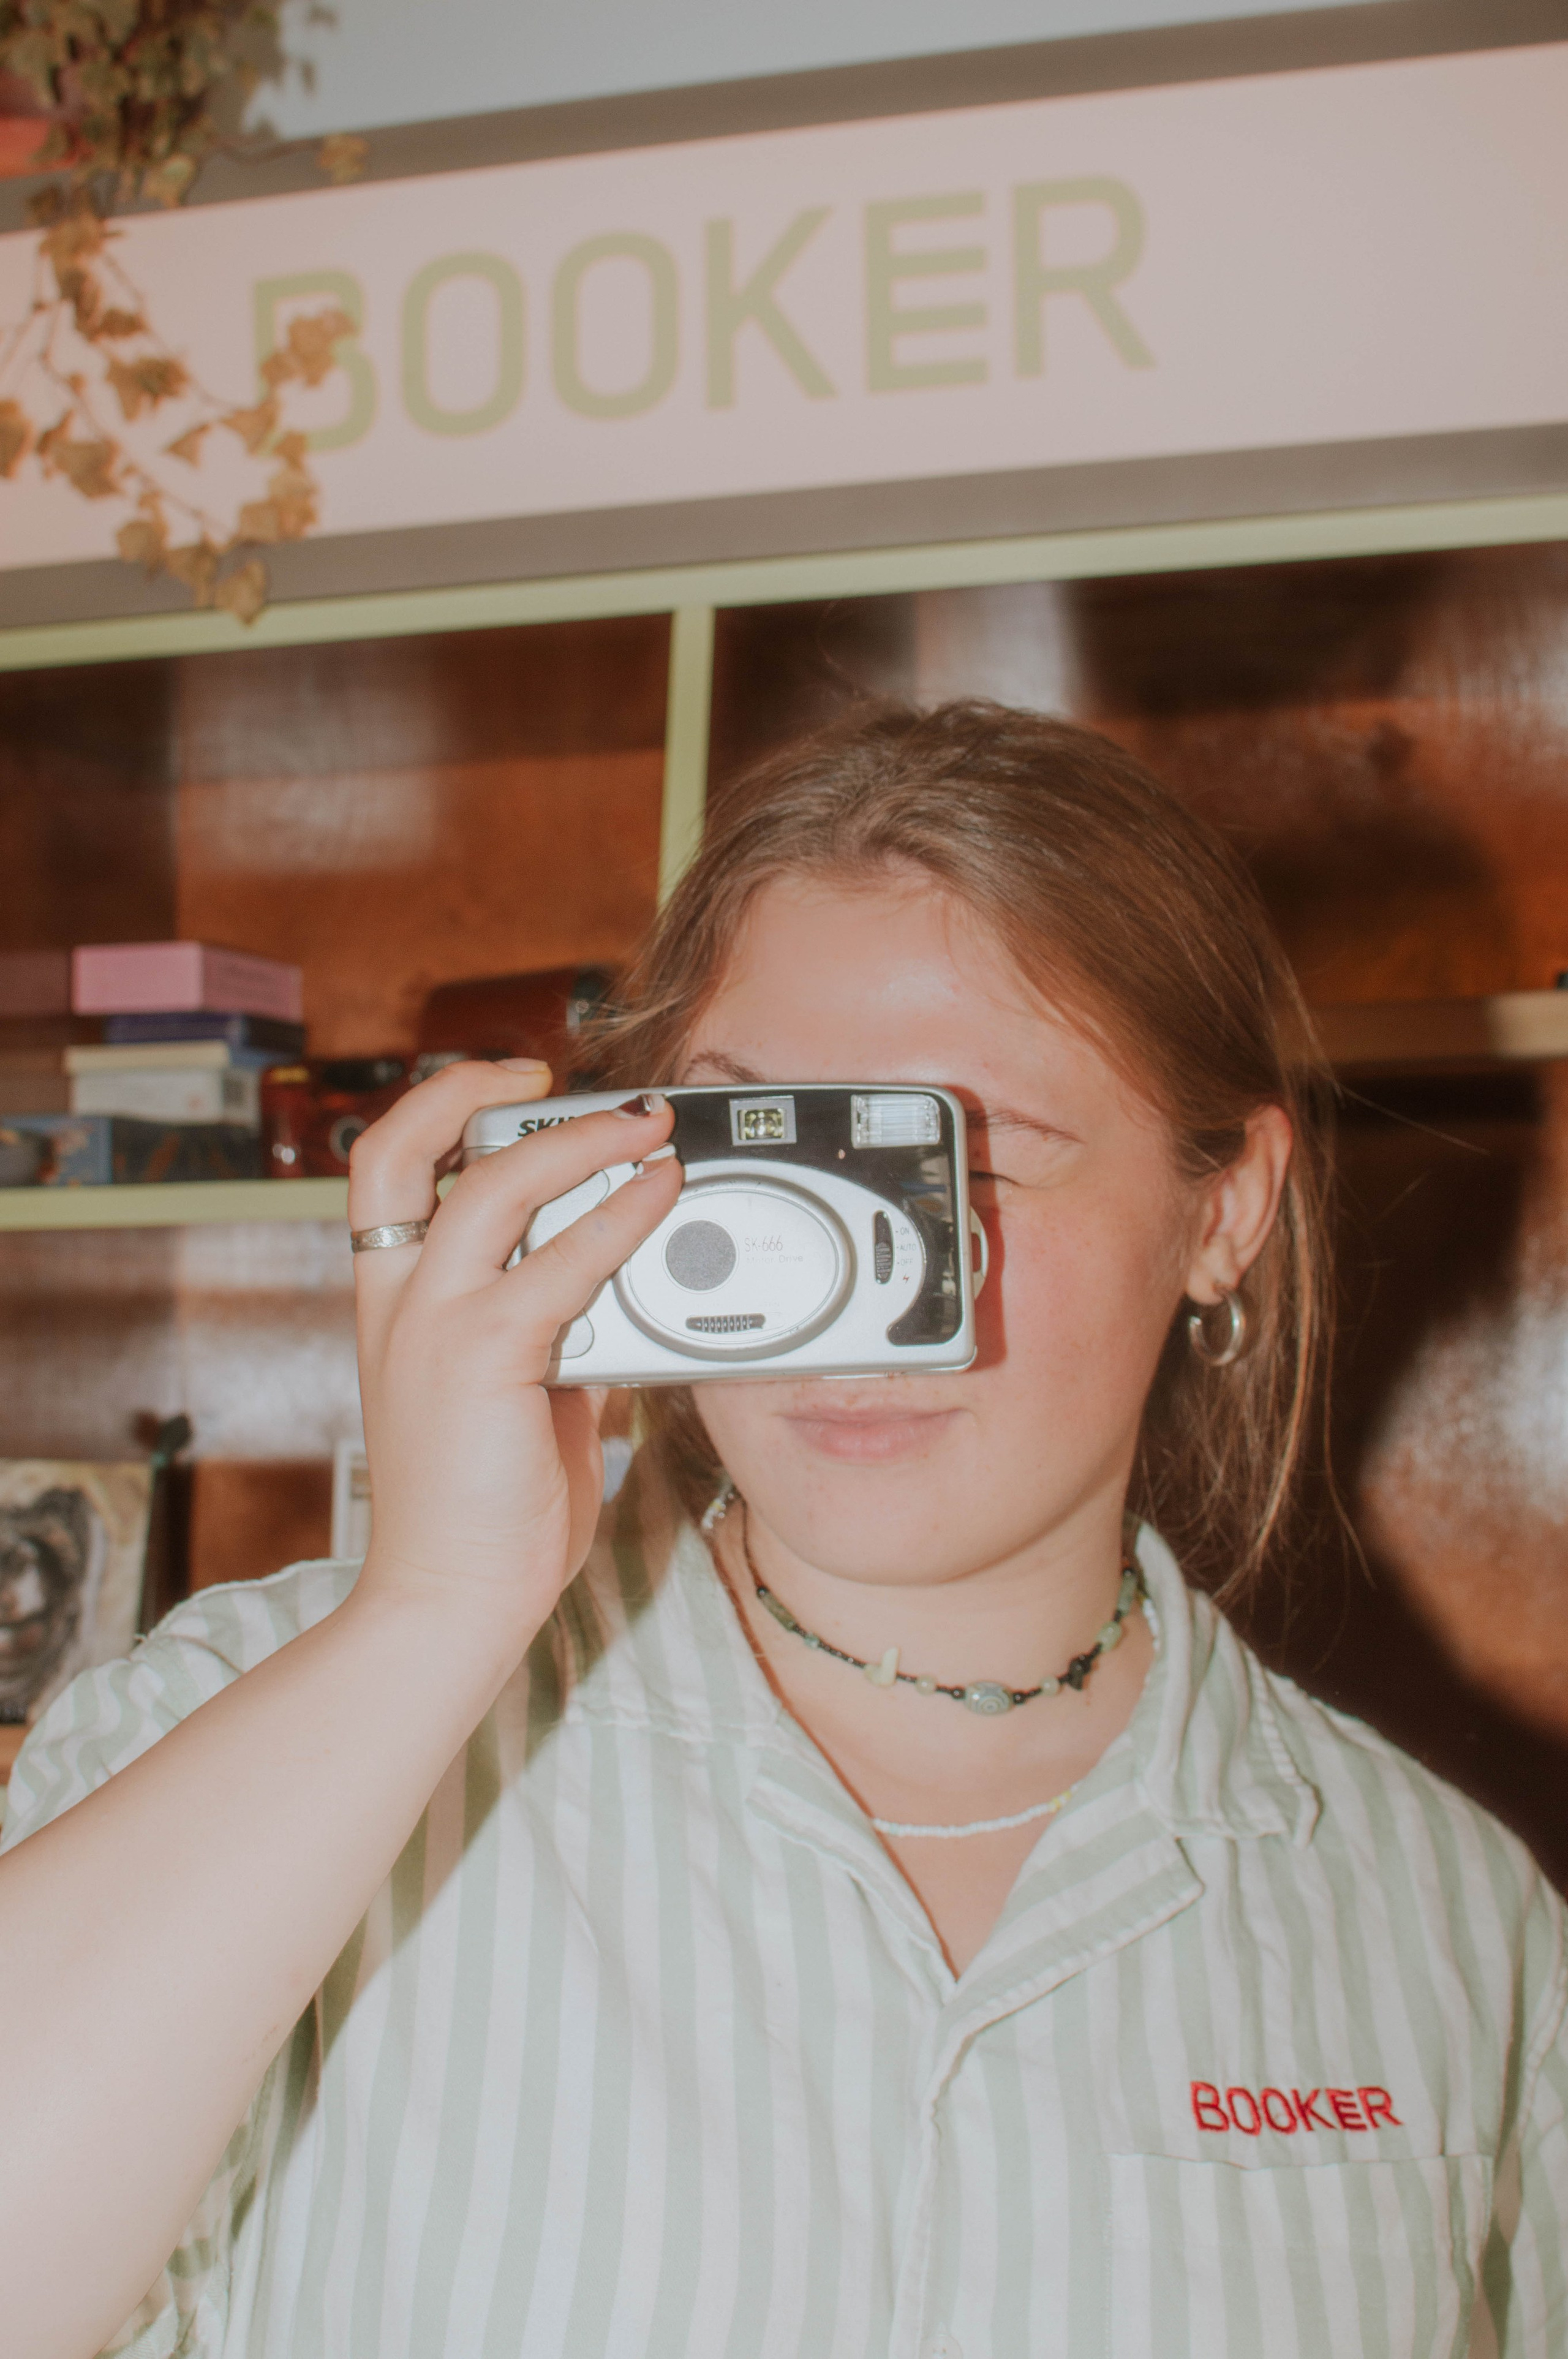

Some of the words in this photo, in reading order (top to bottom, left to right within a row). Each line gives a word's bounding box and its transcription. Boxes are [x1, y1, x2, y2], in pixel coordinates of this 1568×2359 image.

[252, 174, 1155, 456] BOOKER
[900, 1227, 910, 1236] ON
[744, 1236, 783, 1252] SK-666
[779, 1255, 803, 1263] Drive
[1190, 2081, 1403, 2136] BOOKER
